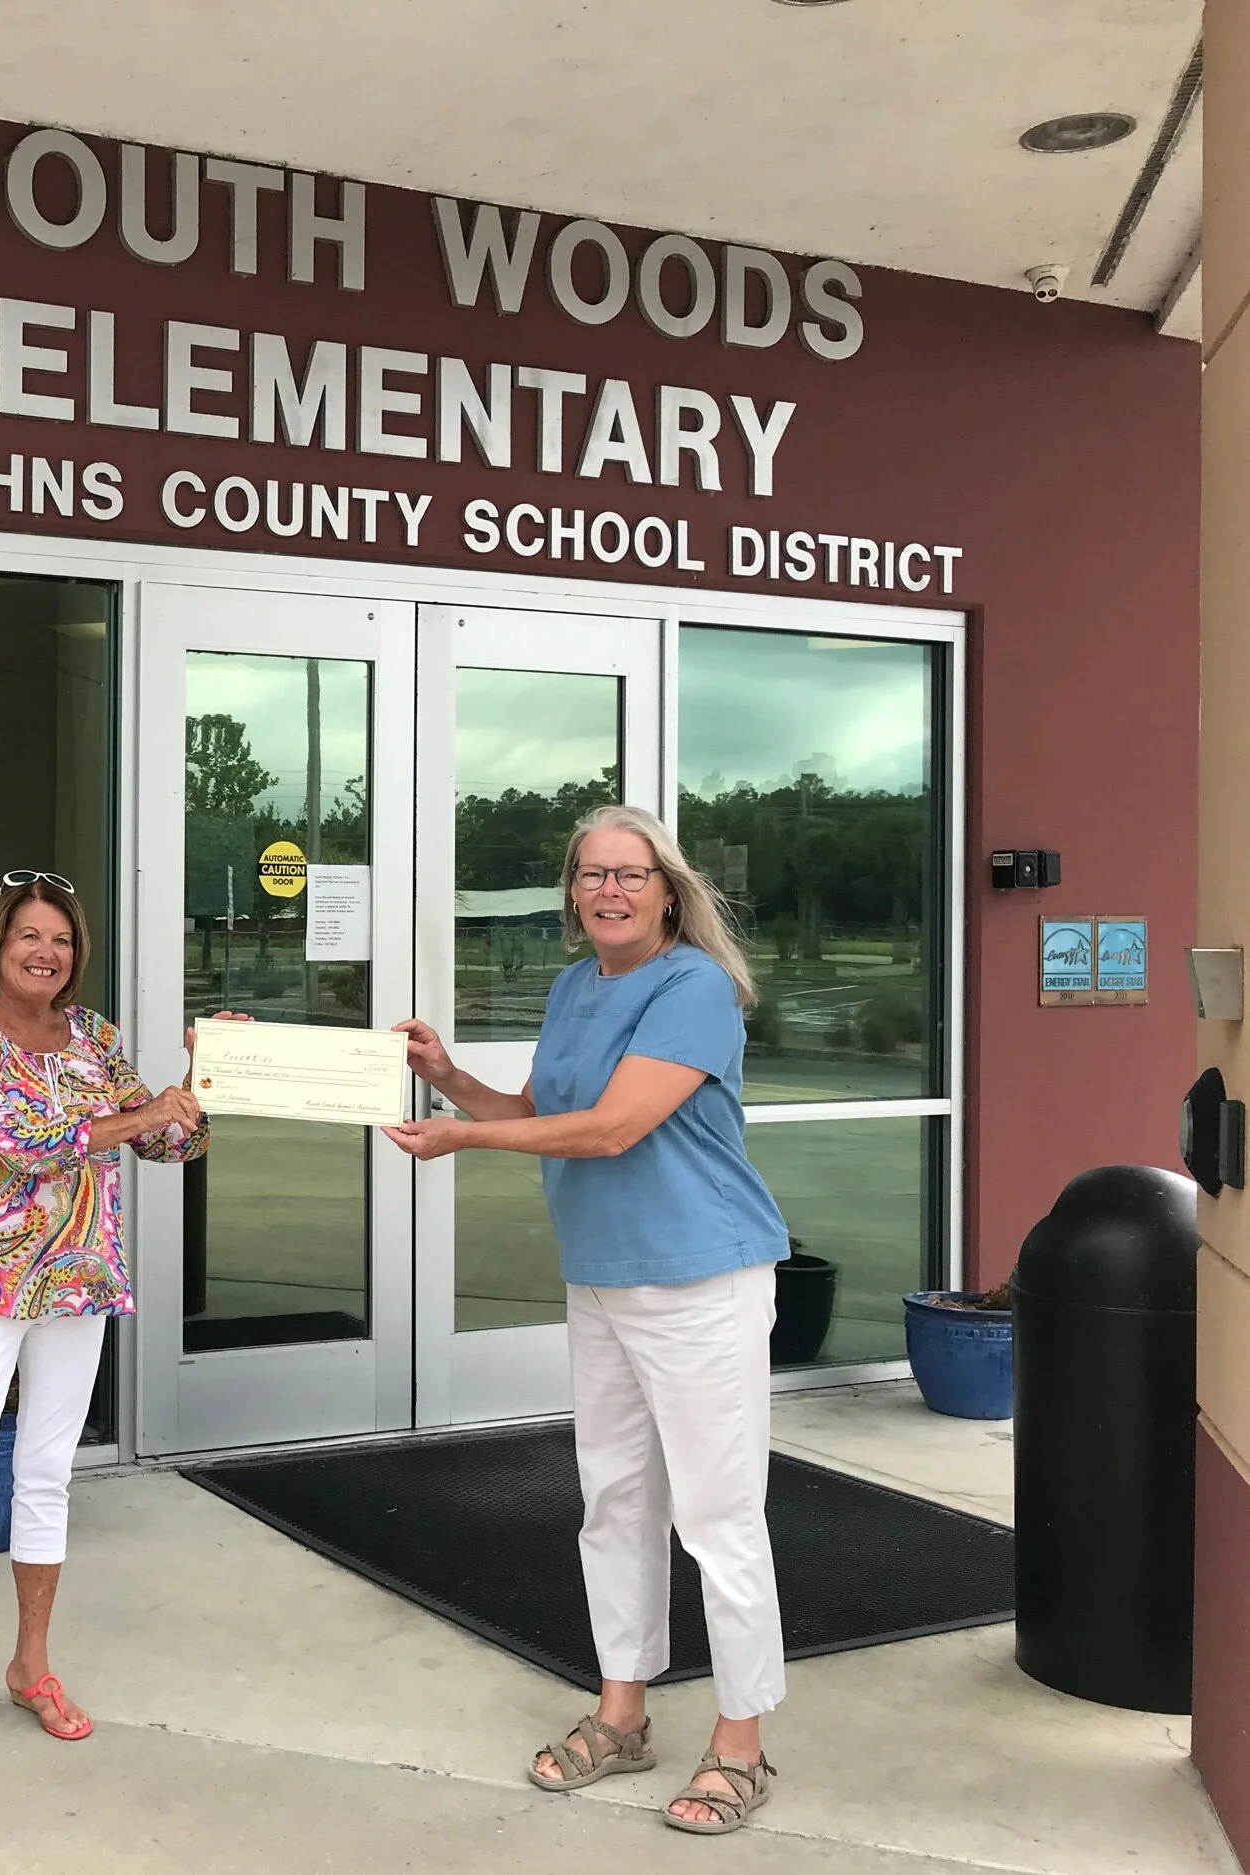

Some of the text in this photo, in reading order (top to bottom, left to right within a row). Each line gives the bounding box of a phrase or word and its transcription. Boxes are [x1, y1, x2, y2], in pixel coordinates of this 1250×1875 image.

[432, 196, 864, 361] WOODS
[161, 470, 432, 547] COUNTY
[463, 499, 705, 572] SCHOOL
[728, 525, 962, 593] DISTRICT
[263, 855, 304, 863] AUTOMATIC
[261, 865, 306, 876] CAUTION
[272, 878, 294, 886] DOOR
[1045, 977, 1090, 987] ENERGY STAR
[1099, 976, 1143, 987] ENERGY STAR
